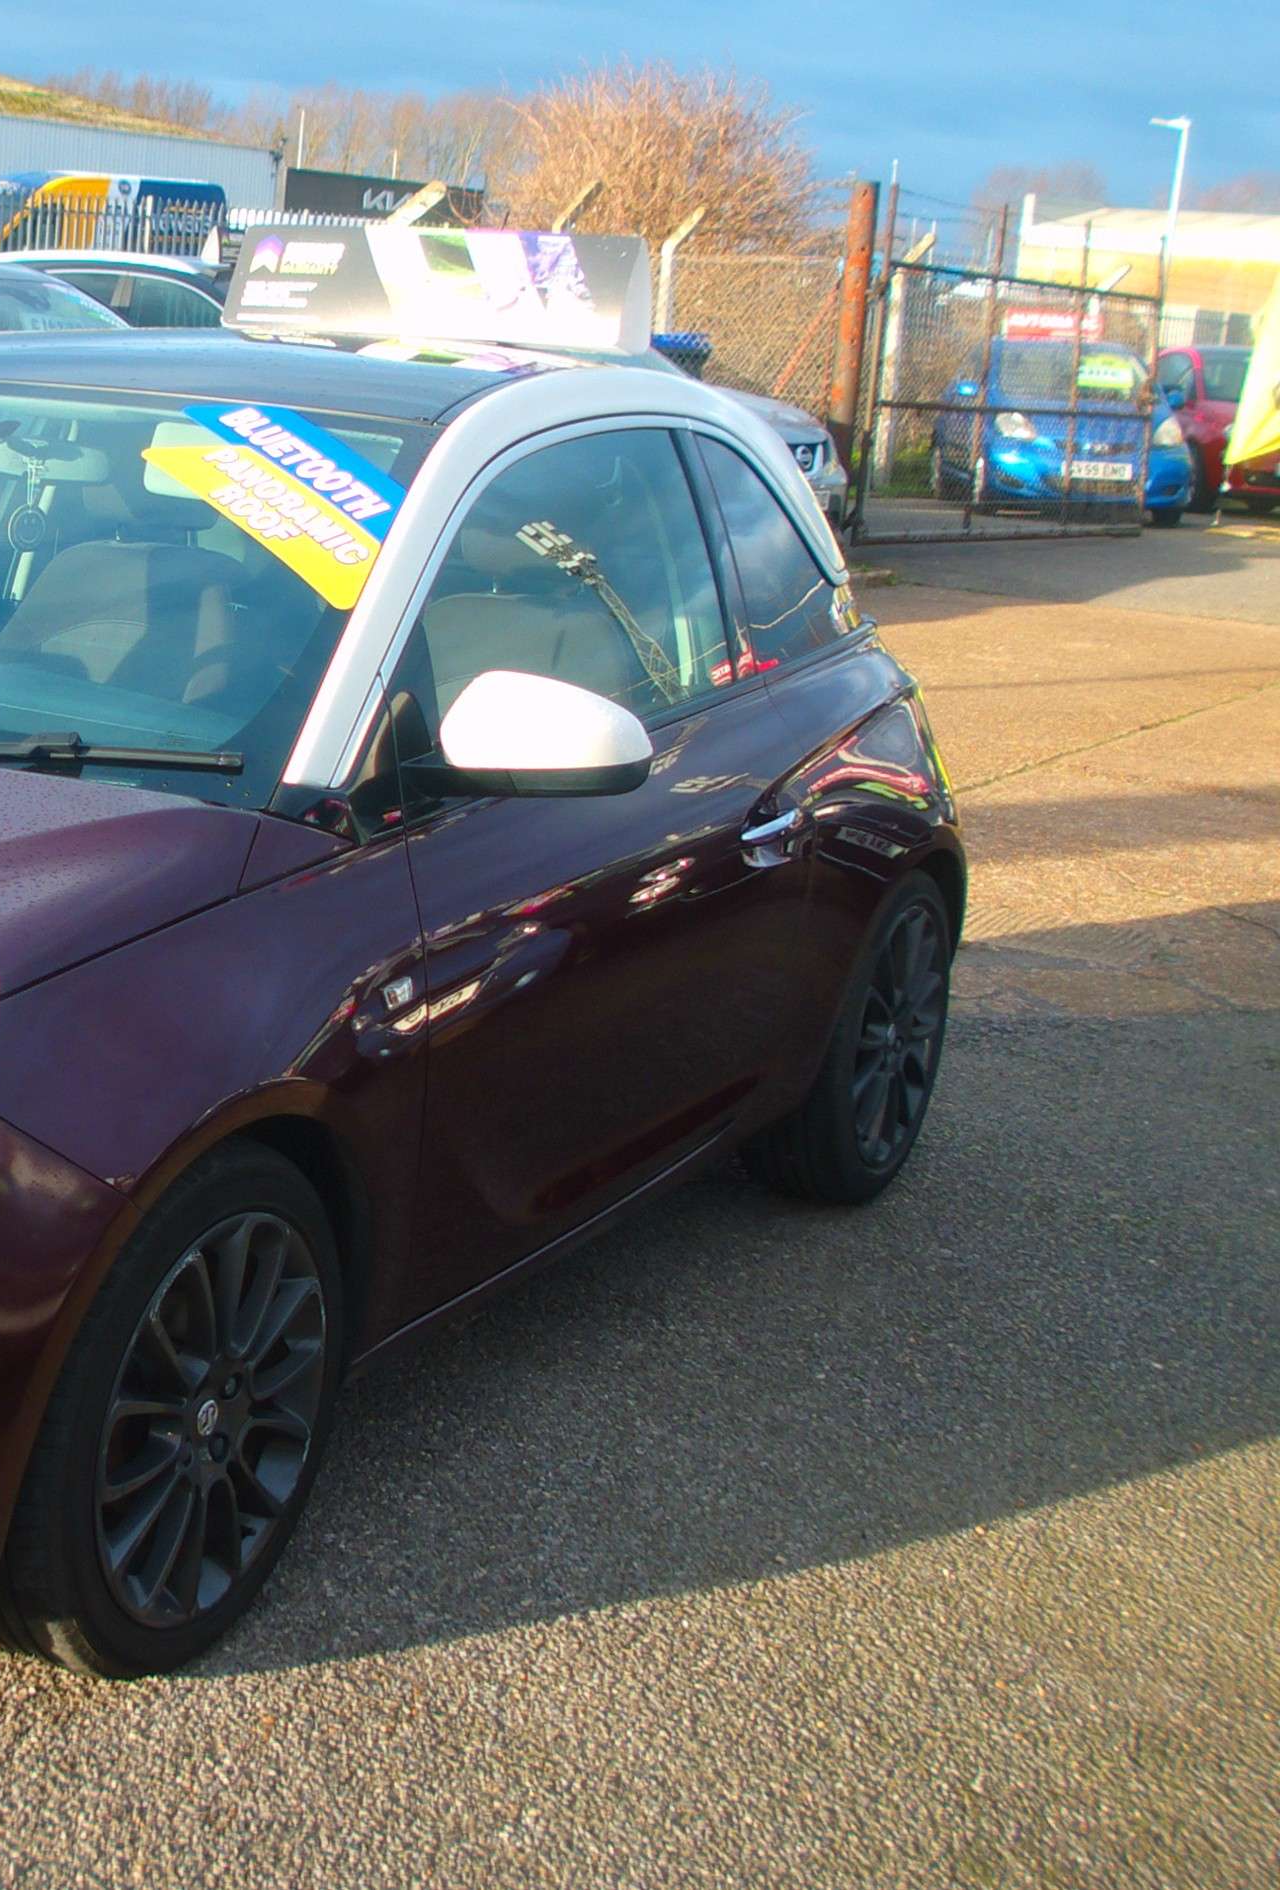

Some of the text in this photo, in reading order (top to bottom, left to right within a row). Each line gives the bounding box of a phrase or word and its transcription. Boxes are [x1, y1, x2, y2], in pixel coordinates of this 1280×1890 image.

[202, 450, 369, 565] PANORAMIC
[209, 484, 303, 541] ROOF
[218, 407, 391, 521] BLUETOOTH
